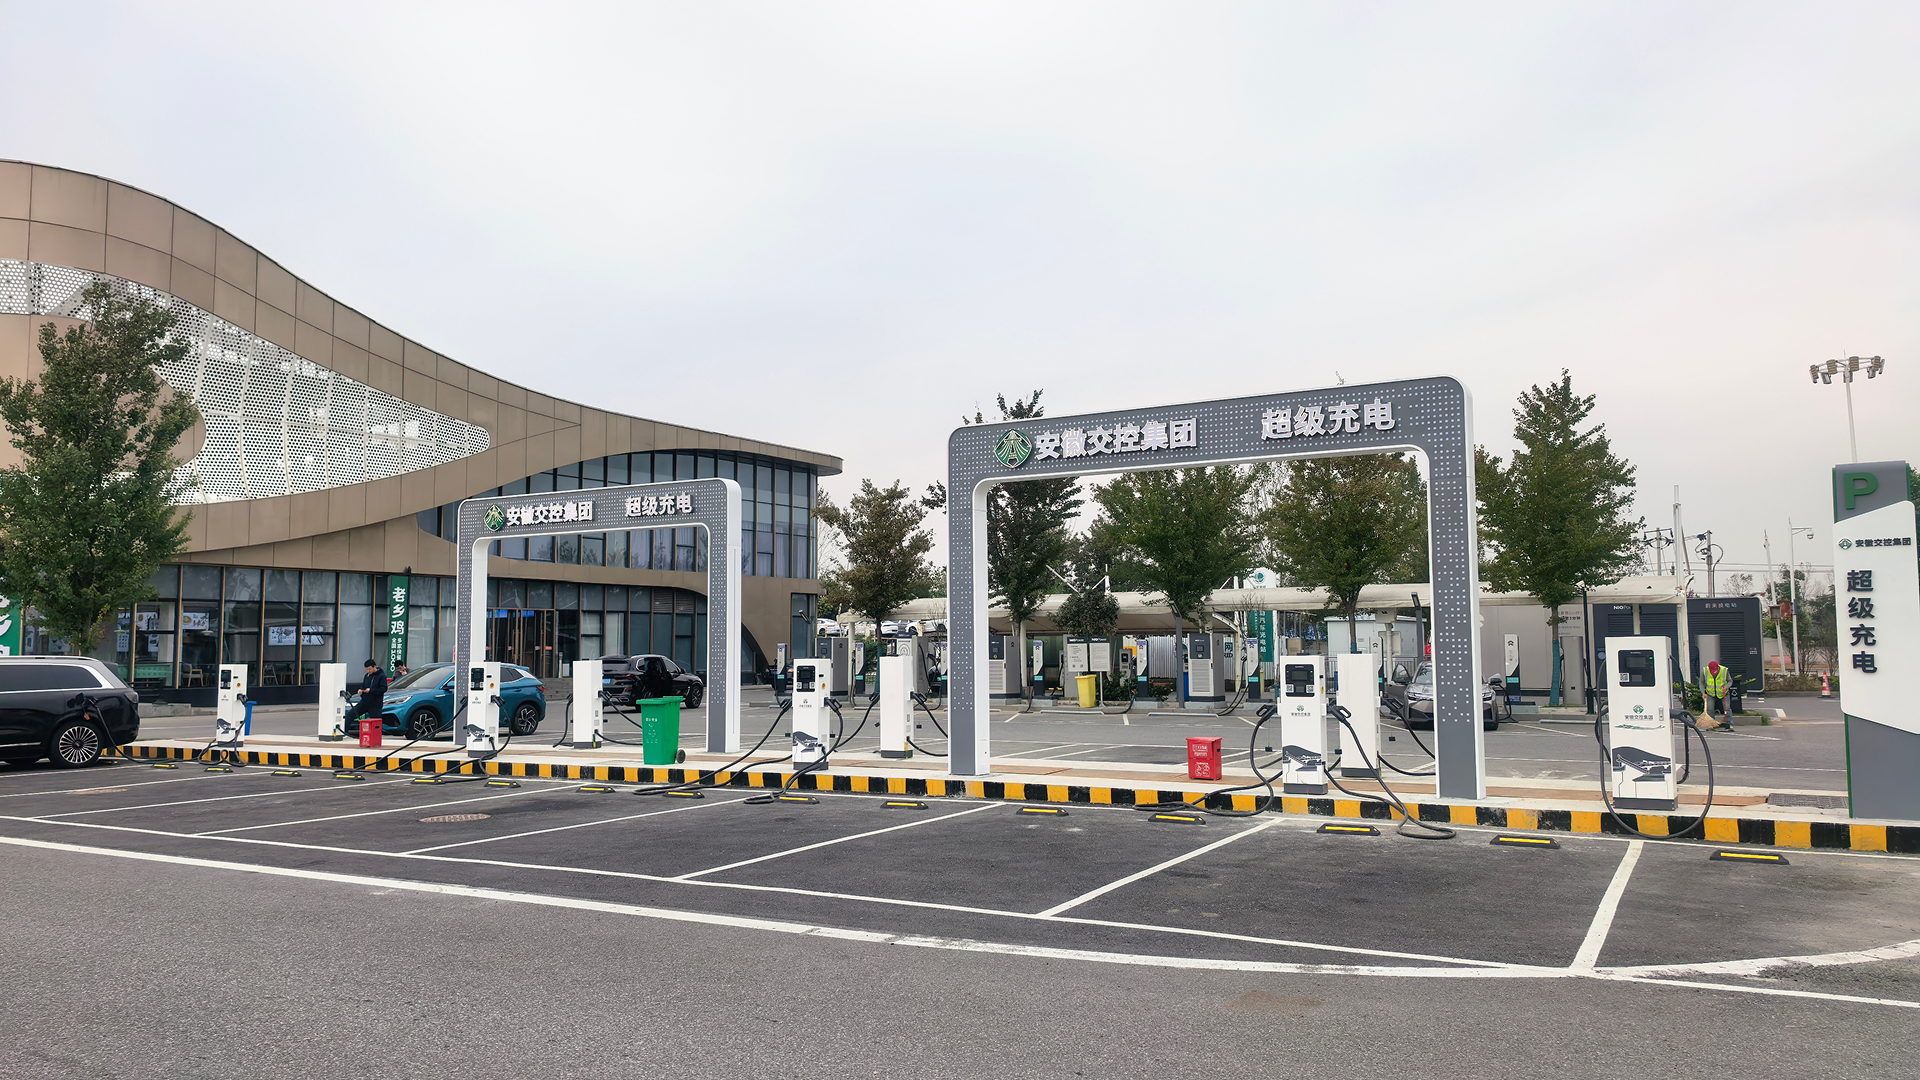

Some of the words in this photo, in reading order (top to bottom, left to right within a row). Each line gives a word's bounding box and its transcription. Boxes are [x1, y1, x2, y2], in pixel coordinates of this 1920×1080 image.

[1035, 417, 1197, 460] 安徽交控集团
[1260, 398, 1396, 441] 超级充电
[625, 491, 693, 517] 超级充电
[1843, 472, 1878, 509] P
[506, 501, 594, 526] 安徽交控集团
[1855, 537, 1911, 547] 安徽交控集团
[390, 586, 406, 635] 老乡鸡
[1847, 569, 1878, 673] 超级充电
